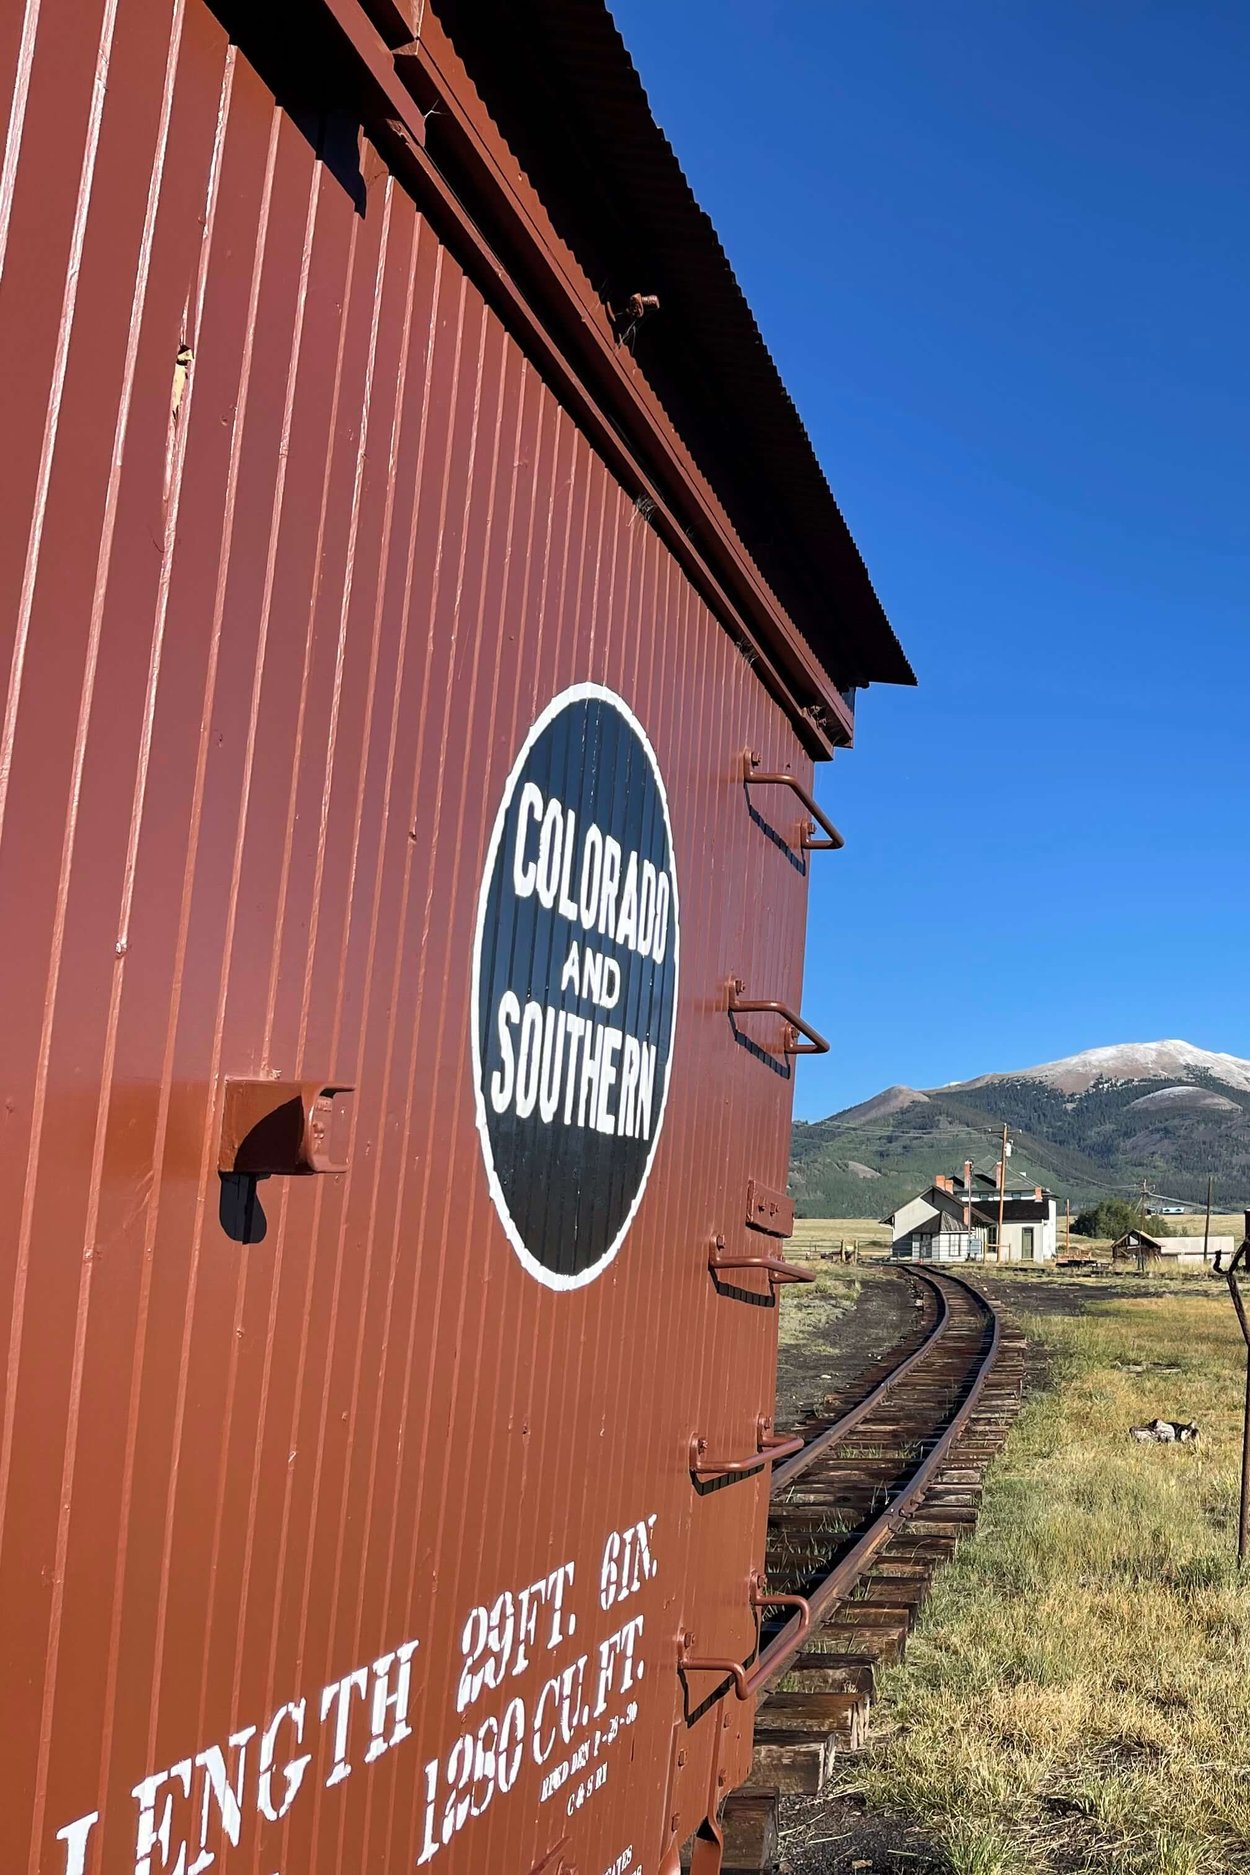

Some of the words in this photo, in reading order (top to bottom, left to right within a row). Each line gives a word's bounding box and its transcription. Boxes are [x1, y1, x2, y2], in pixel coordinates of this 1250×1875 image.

[512, 781, 670, 965] COLORADO
[560, 940, 622, 1010] AND
[490, 990, 658, 1142] SOUTHERN
